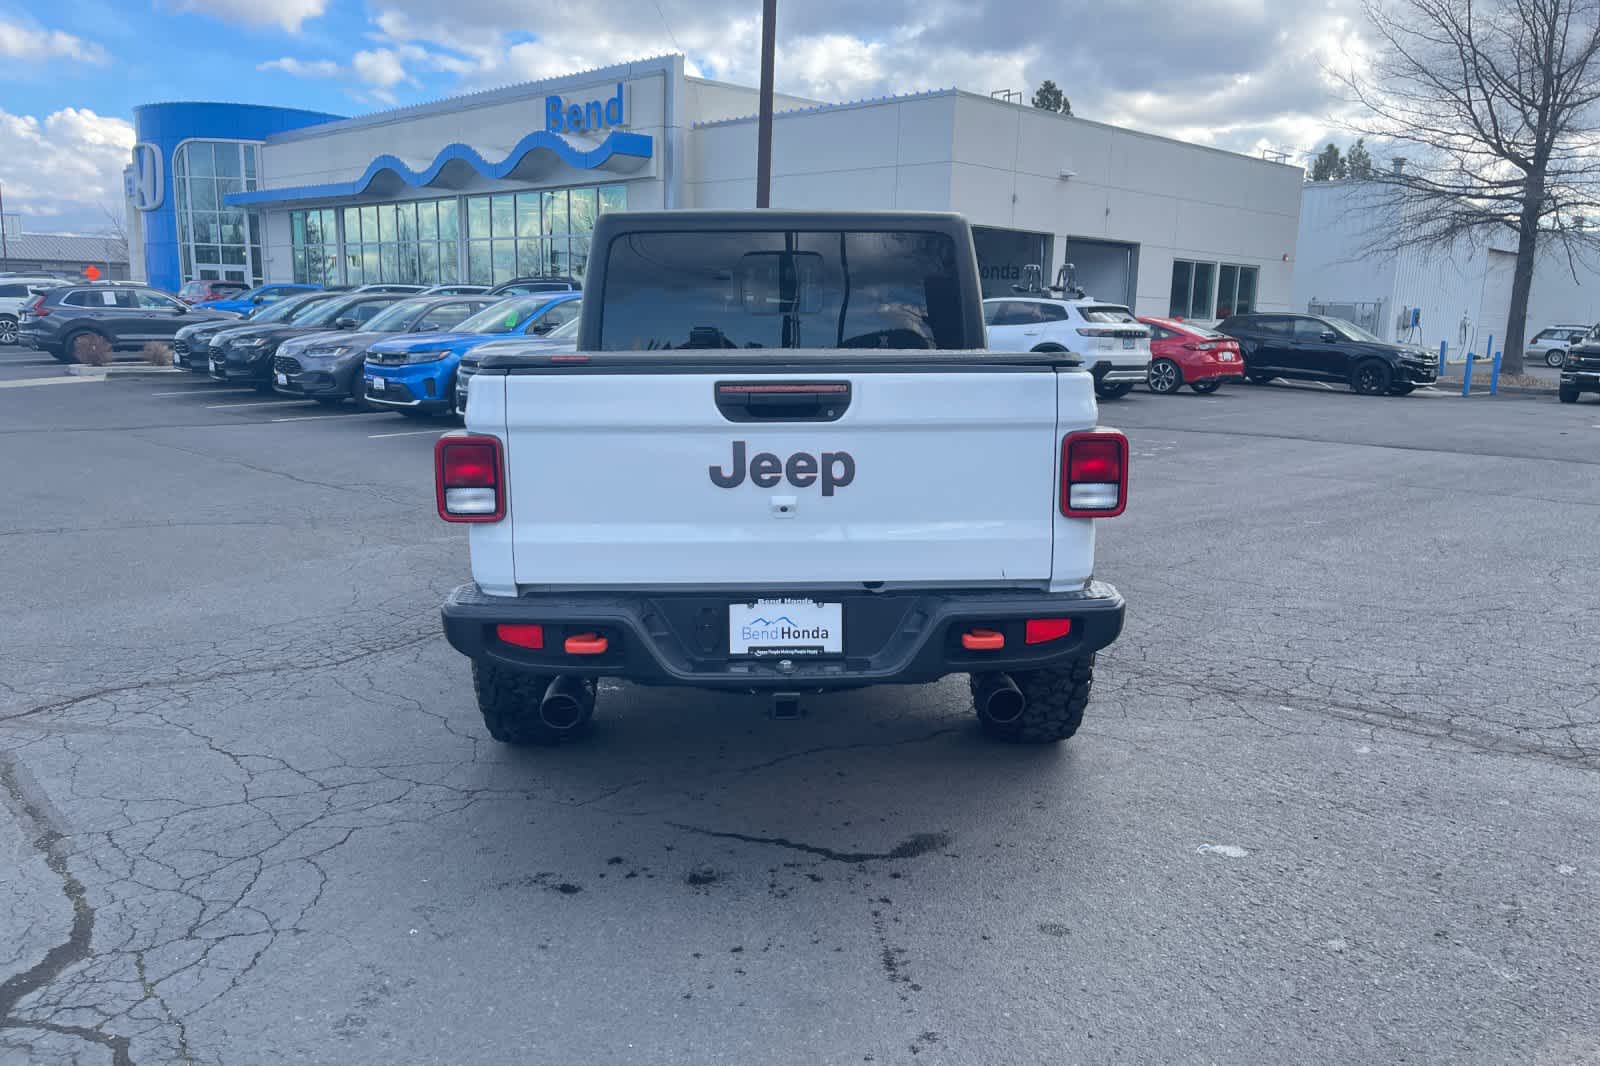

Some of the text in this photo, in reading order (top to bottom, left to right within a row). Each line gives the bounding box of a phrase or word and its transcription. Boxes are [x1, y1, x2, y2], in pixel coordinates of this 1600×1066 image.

[545, 82, 624, 131] Bend
[981, 264, 1020, 280] onda
[709, 440, 856, 497] Jeep
[757, 597, 814, 606] Bend Honda
[742, 626, 829, 640] Bend Honda
